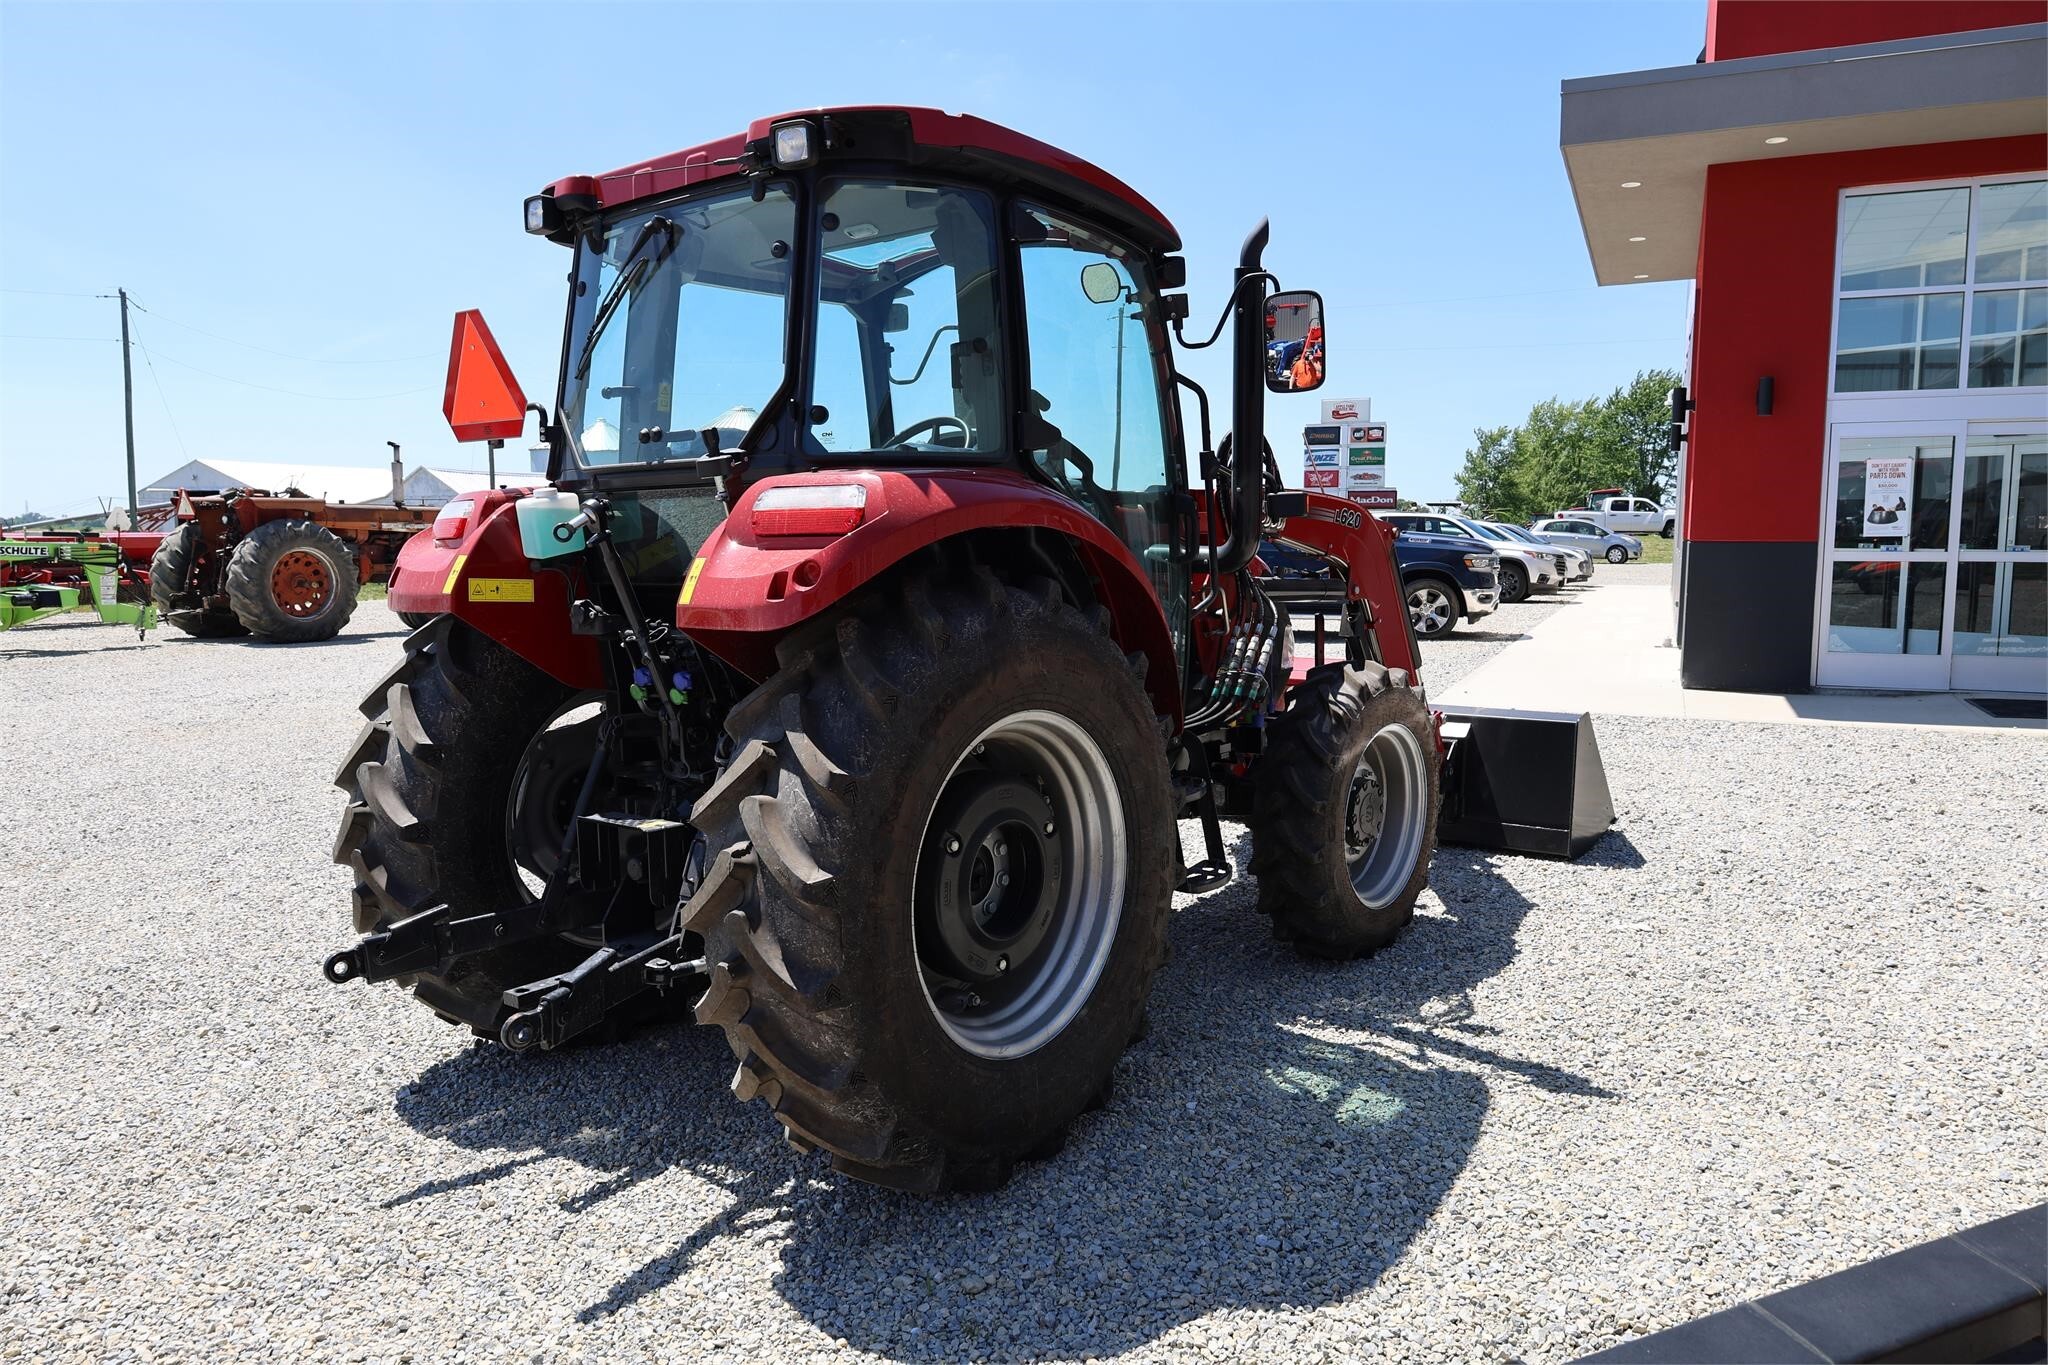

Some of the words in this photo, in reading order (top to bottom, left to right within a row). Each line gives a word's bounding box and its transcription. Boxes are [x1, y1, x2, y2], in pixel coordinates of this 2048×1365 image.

[1306, 454, 1337, 462] KINZE
[1334, 508, 1361, 529] L620
[0, 546, 47, 555] SCHULTE
